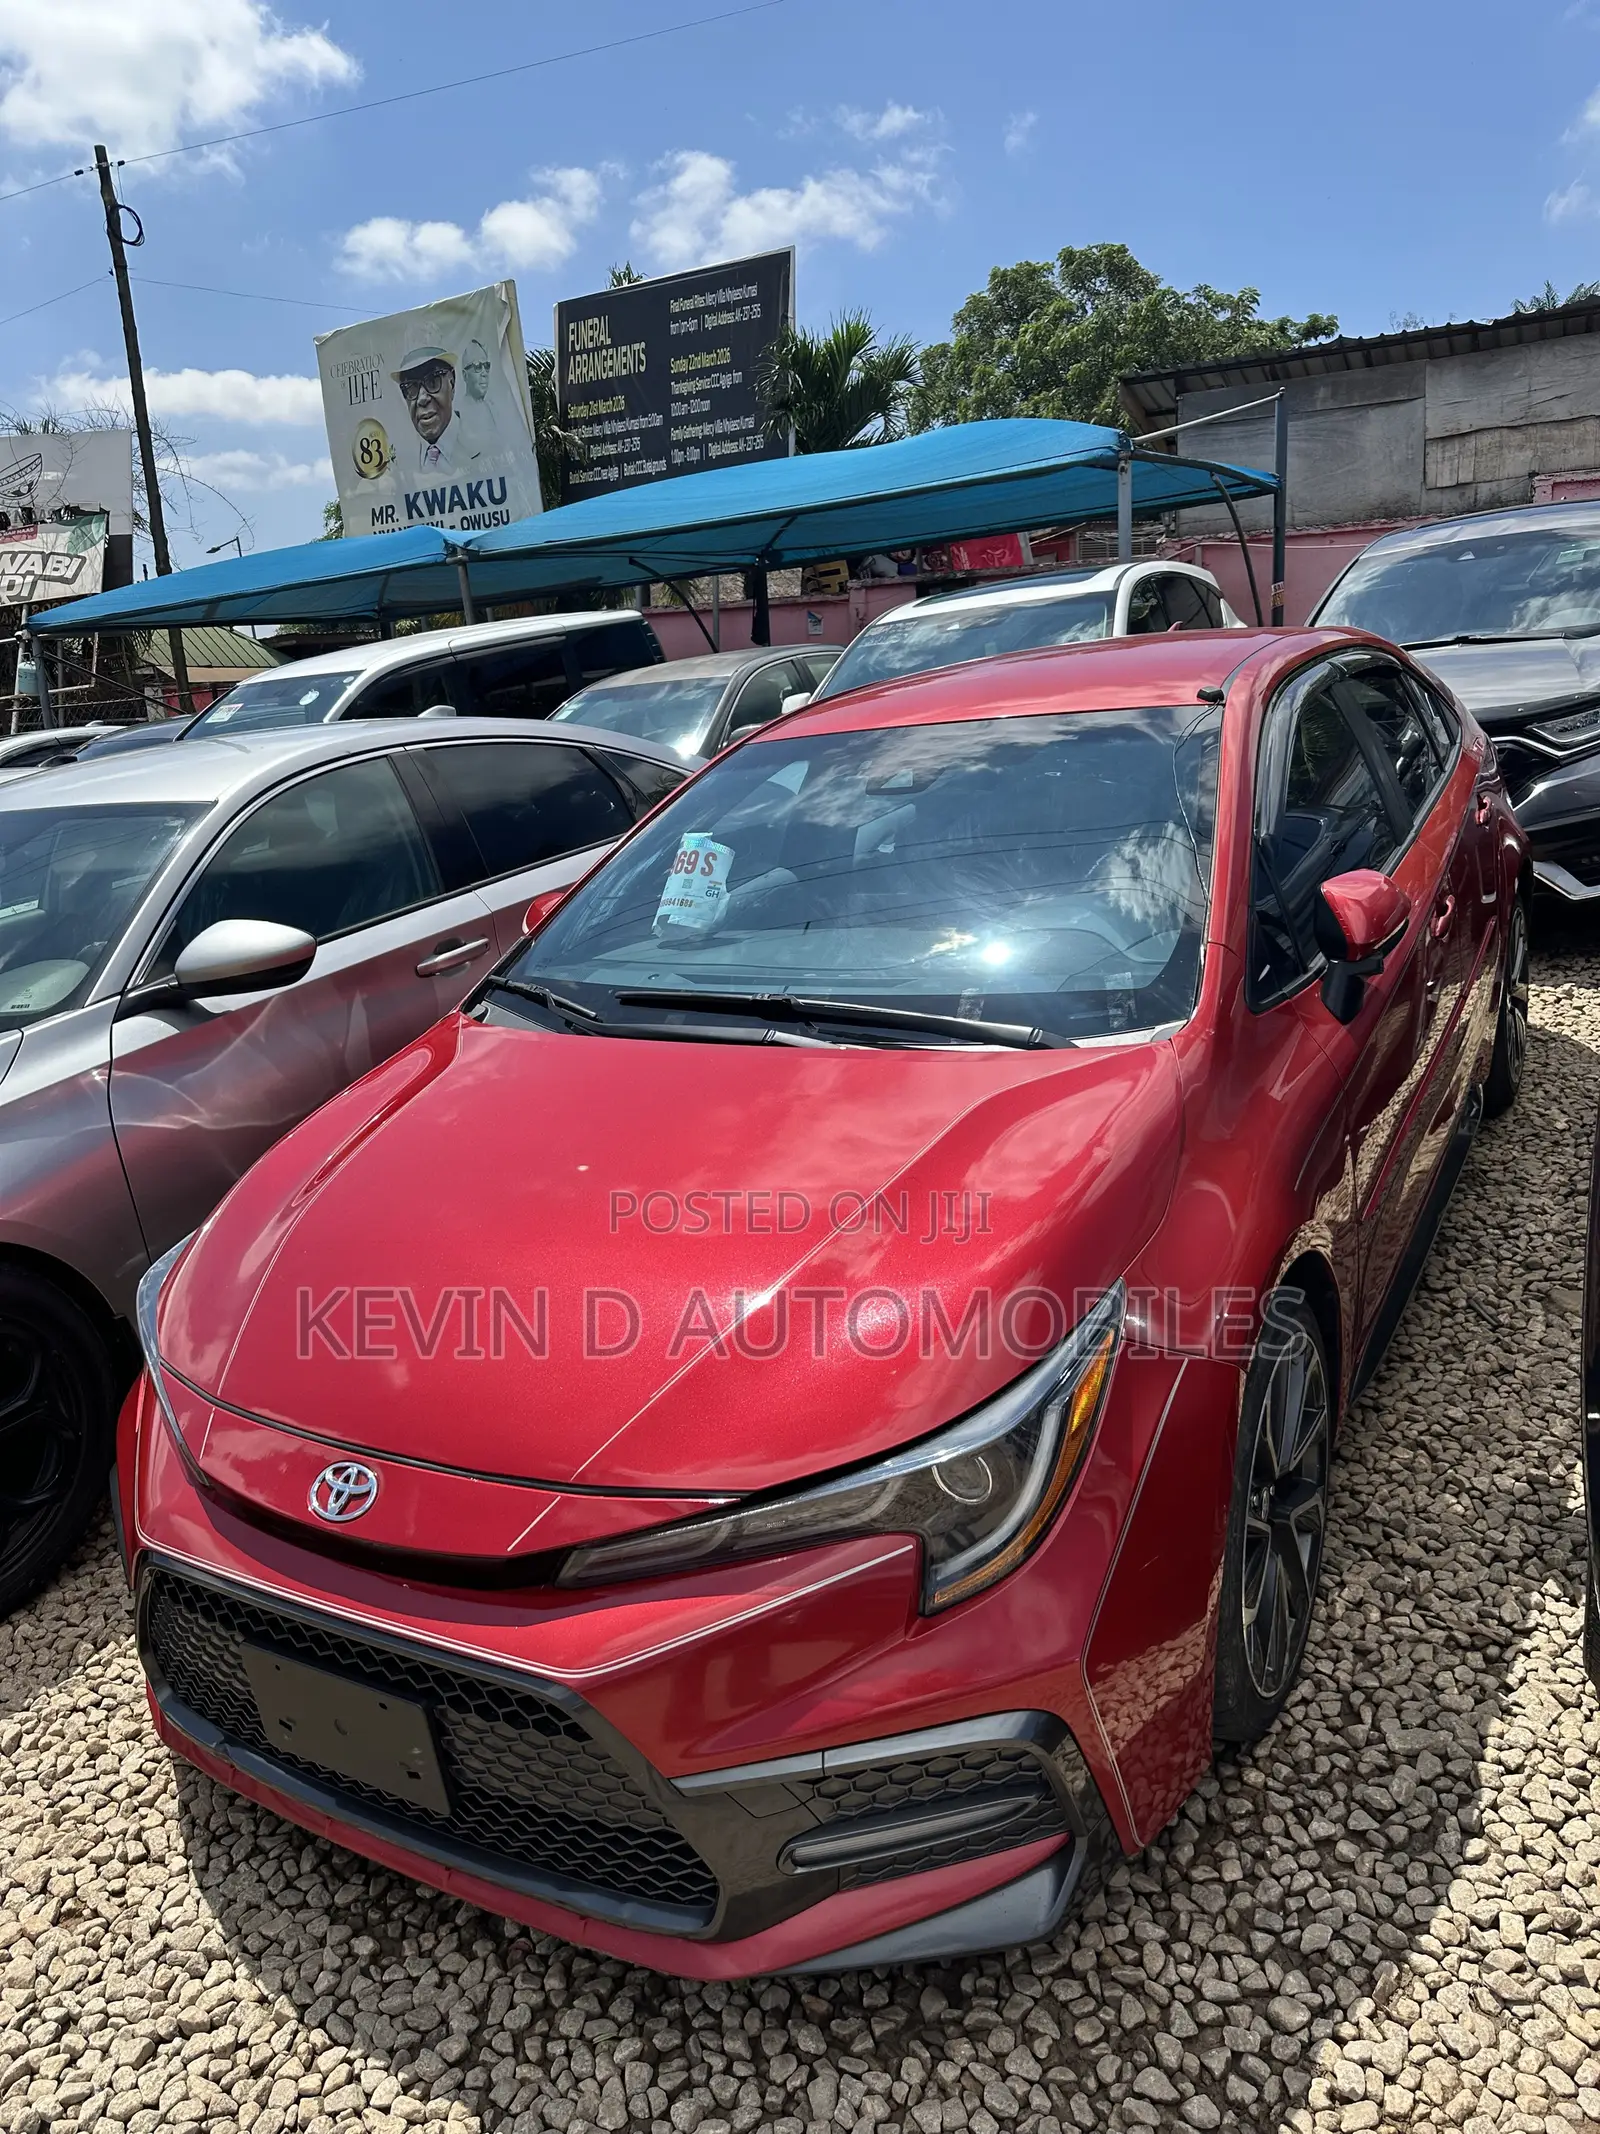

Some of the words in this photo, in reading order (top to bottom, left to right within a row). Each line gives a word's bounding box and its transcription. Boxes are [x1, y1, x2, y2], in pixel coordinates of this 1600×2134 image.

[568, 315, 611, 352] FUNERAL
[705, 312, 718, 331] Digital
[330, 353, 385, 379] CELEBRATION
[567, 341, 646, 385] ARRANGEMENTS
[671, 354, 688, 376] Sunday
[689, 352, 701, 371] 22nd
[702, 349, 716, 368] March
[717, 346, 731, 365] 2026
[348, 369, 383, 406] LIFE
[733, 368, 742, 384] from
[568, 401, 589, 420] Saturday
[589, 399, 598, 416] 21st
[599, 397, 612, 414] March
[613, 395, 625, 412] 2026
[360, 437, 383, 468] 83
[371, 504, 399, 526] MR.
[404, 476, 508, 520] KWAKU
[460, 509, 511, 531] OWUSU
[671, 849, 700, 875] 69
[700, 851, 718, 877] S
[705, 889, 720, 899] GH
